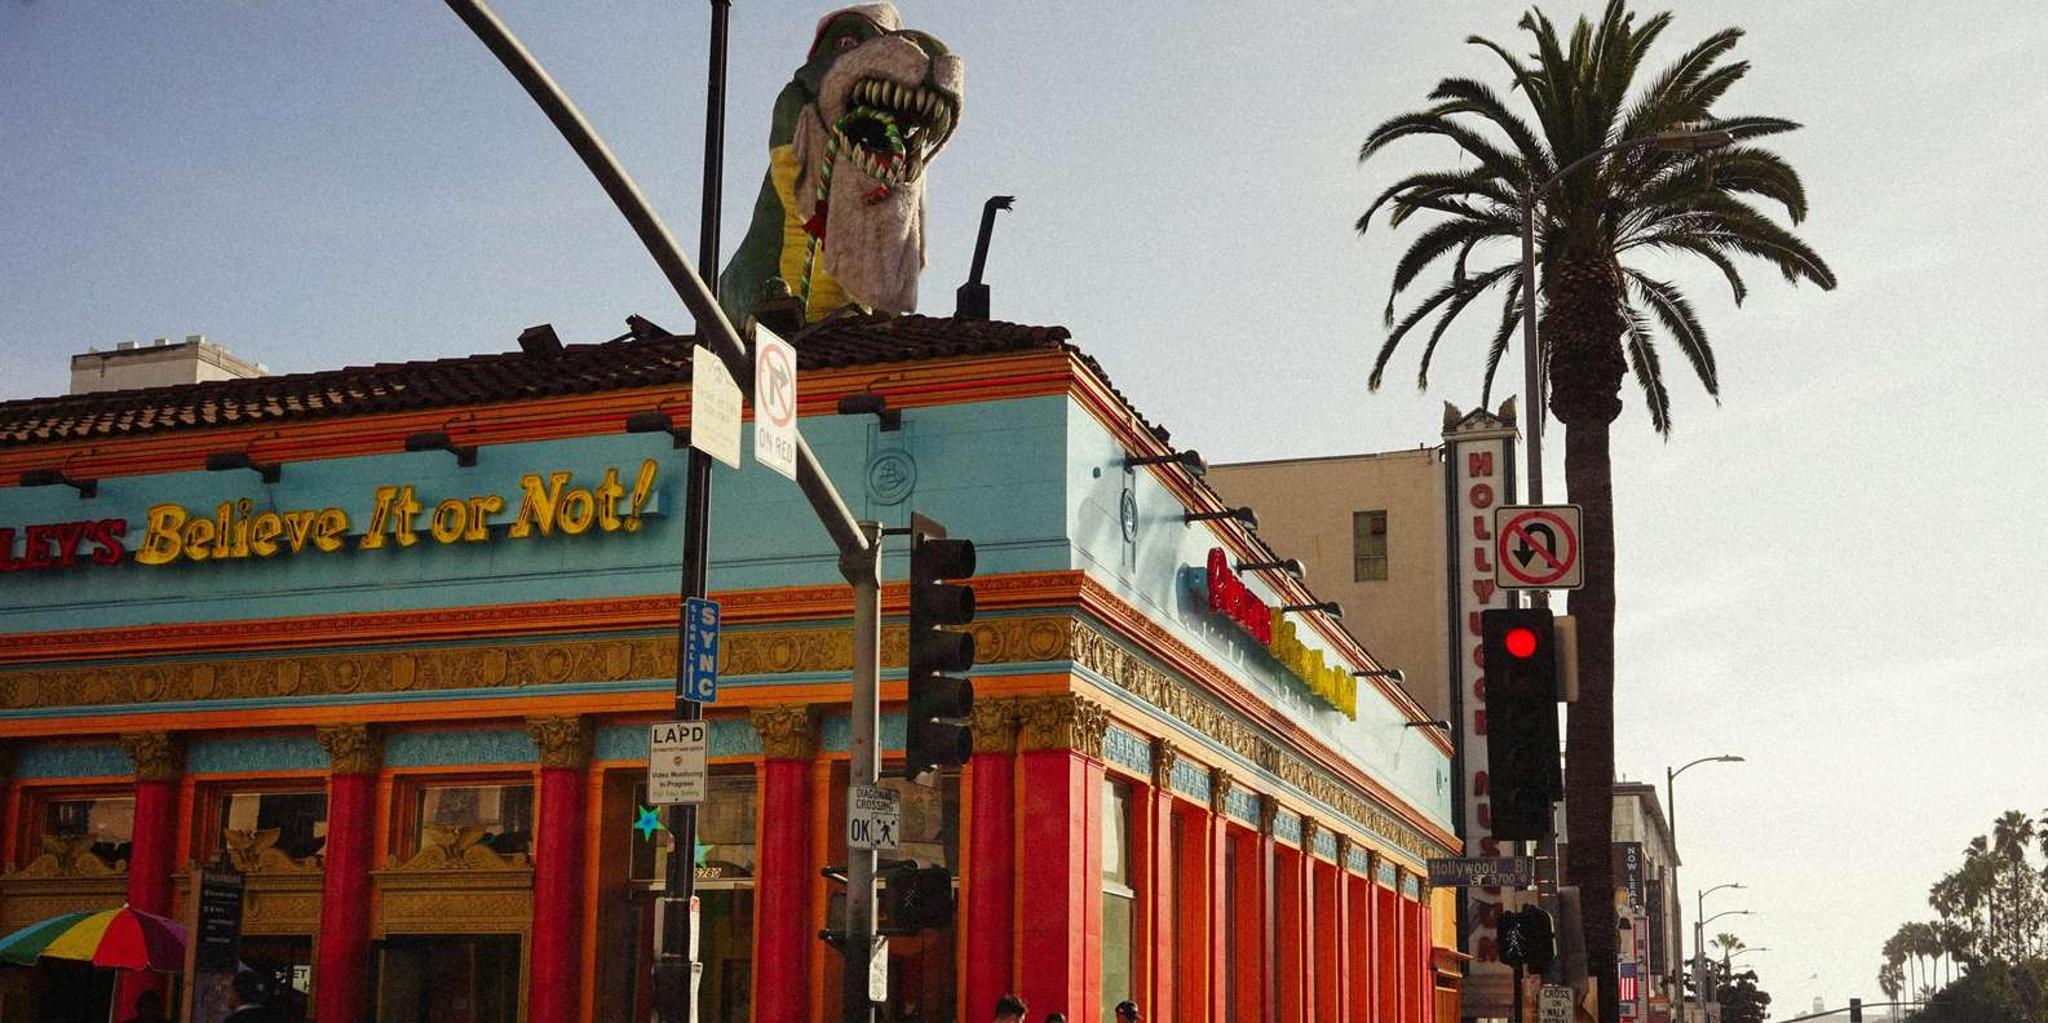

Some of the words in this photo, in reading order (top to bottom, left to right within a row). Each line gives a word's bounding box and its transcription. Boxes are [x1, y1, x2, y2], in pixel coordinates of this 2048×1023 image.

[758, 427, 773, 454] ON
[775, 436, 793, 464] RED
[134, 497, 348, 566] Believe
[359, 484, 422, 549] It
[432, 495, 503, 544] or
[508, 458, 658, 536] Not!
[688, 604, 697, 660] SIGNAL
[698, 606, 717, 697] SYNC
[653, 726, 704, 744] LAPD
[856, 799, 894, 812] CROSSING
[851, 818, 870, 842] OK
[1430, 859, 1497, 878] Hollywood
[1627, 847, 1637, 871] NOW
